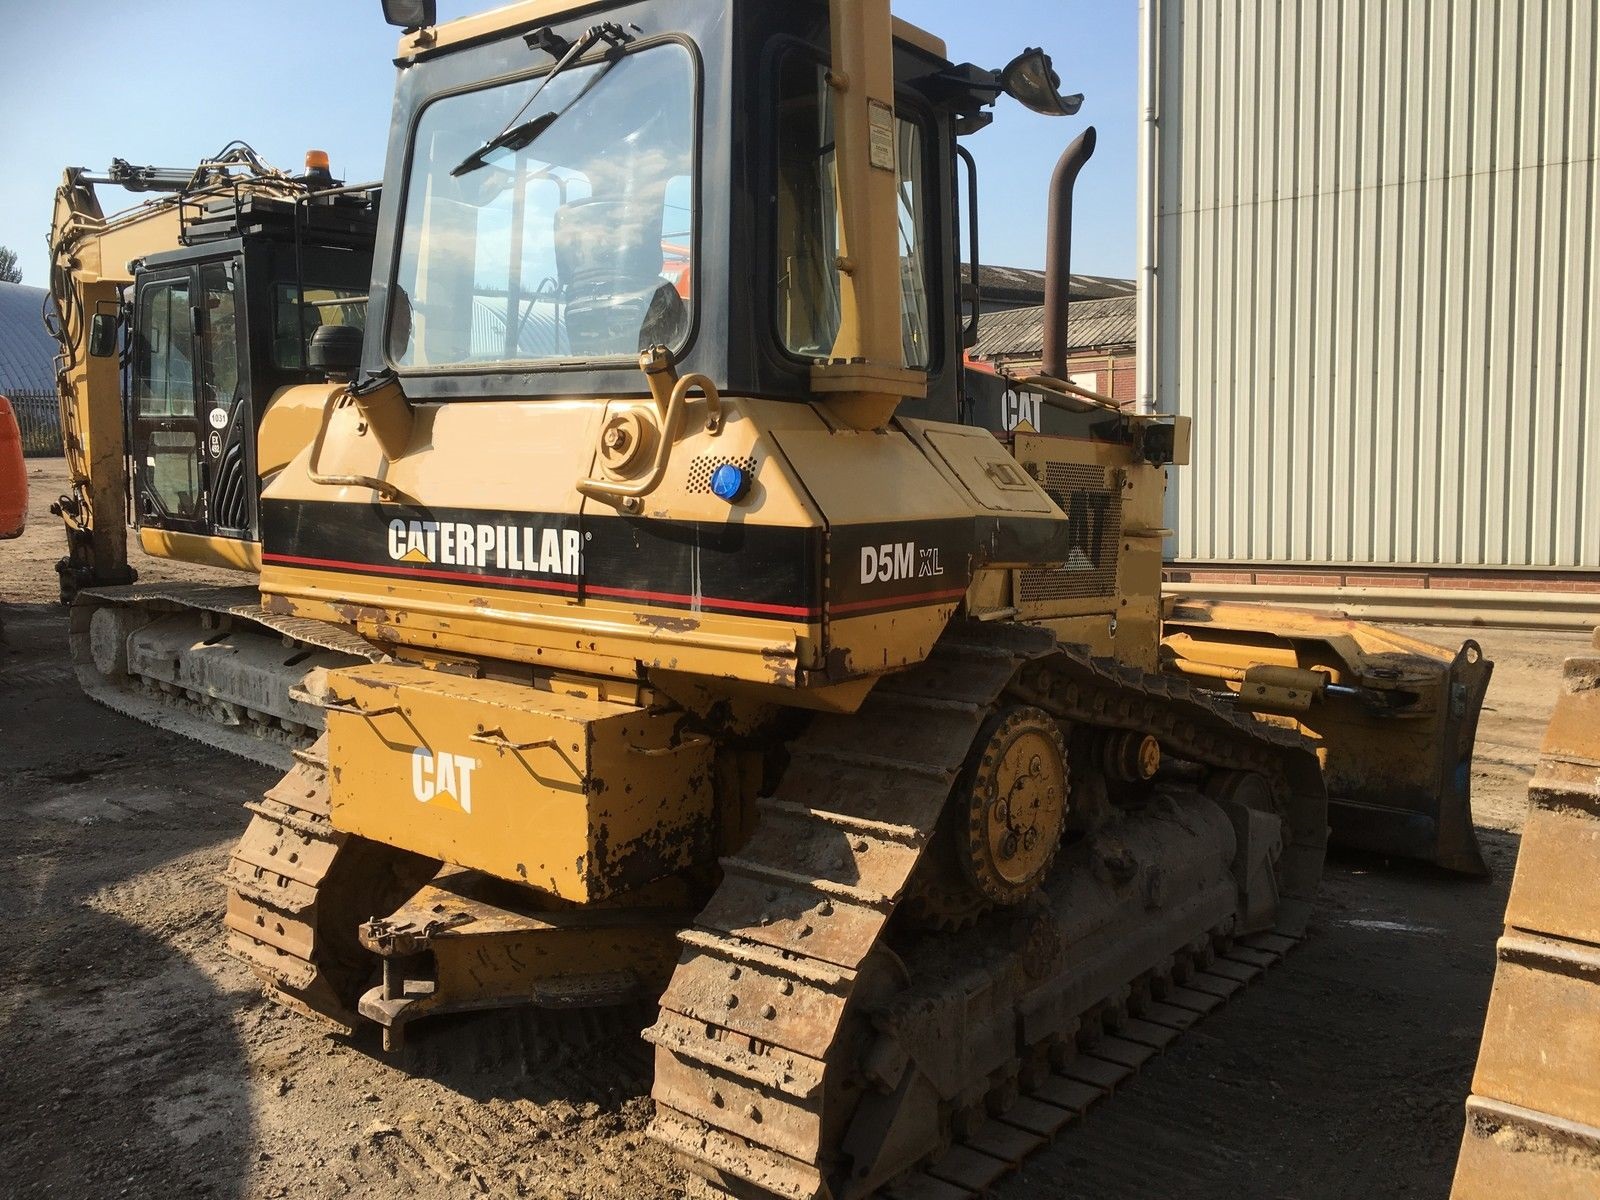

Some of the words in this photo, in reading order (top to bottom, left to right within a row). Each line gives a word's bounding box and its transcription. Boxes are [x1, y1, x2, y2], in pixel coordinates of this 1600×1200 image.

[211, 413, 226, 423] 1031
[1001, 390, 1044, 434] CAT
[388, 518, 585, 576] CATERPILLAR
[860, 542, 915, 585] D5M
[918, 547, 944, 578] XL
[412, 746, 477, 815] CAT
